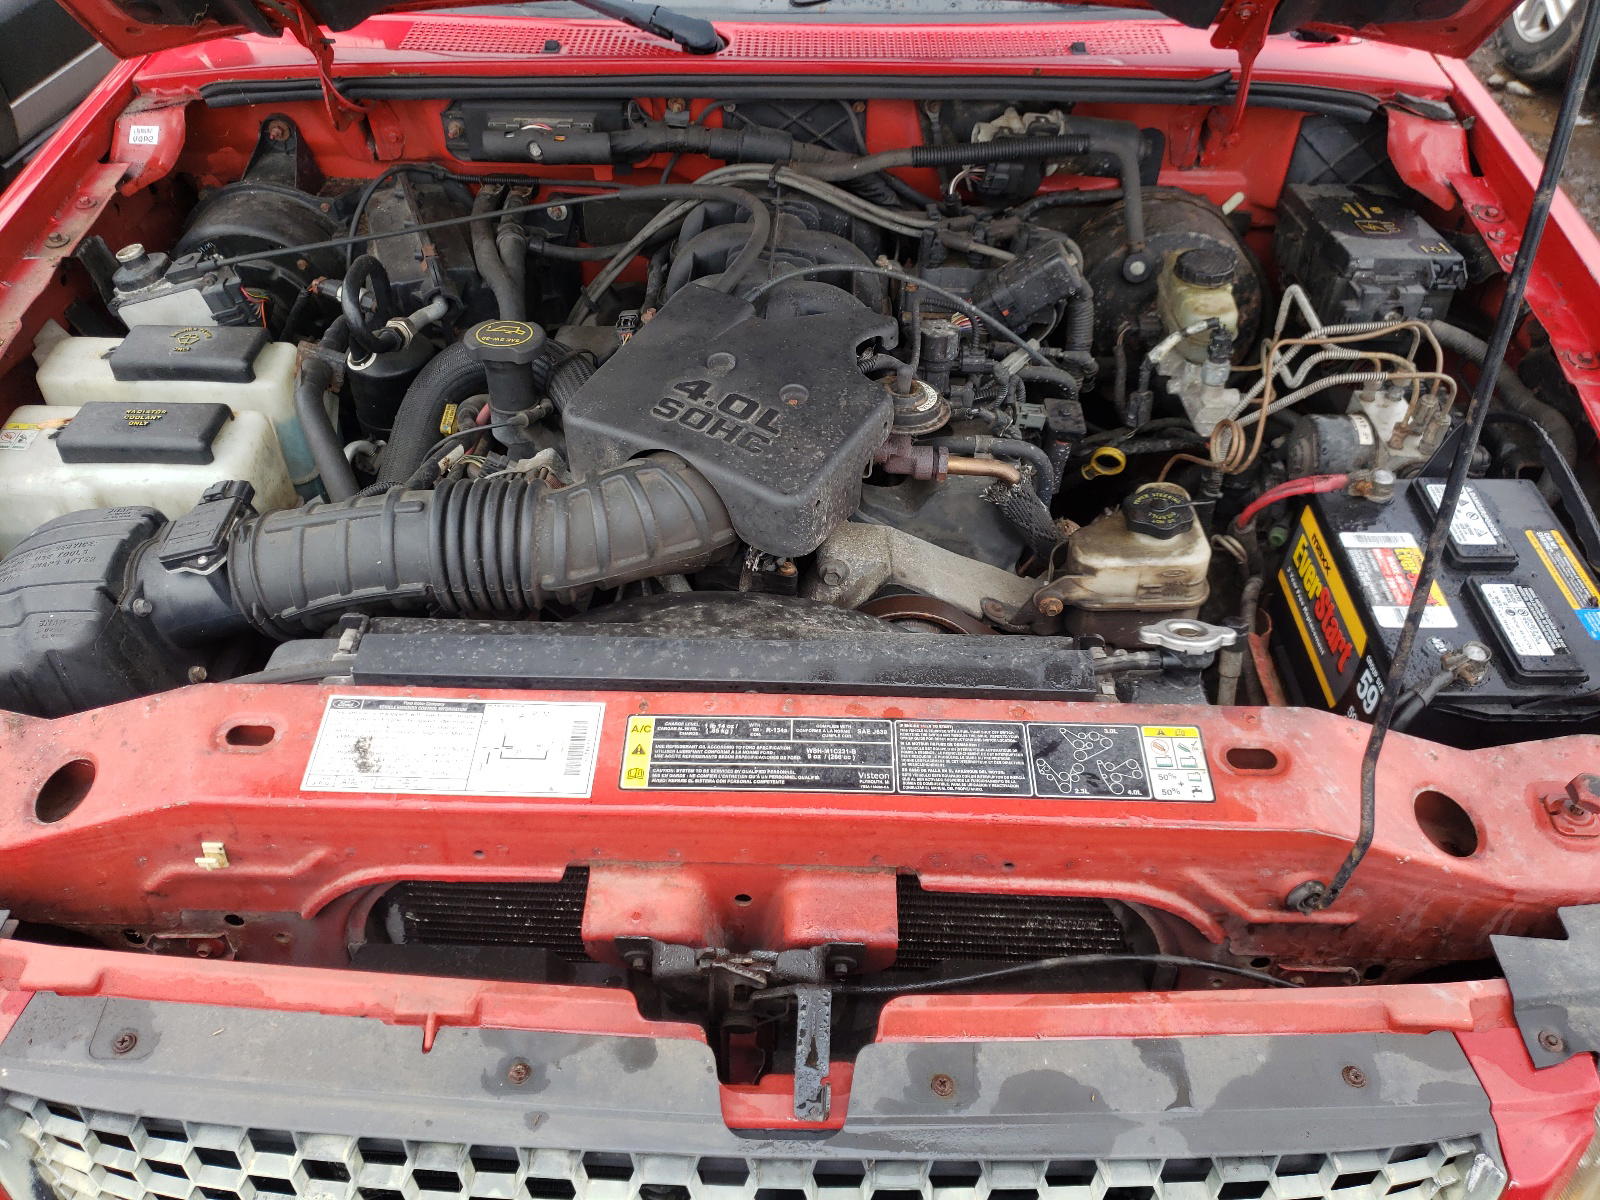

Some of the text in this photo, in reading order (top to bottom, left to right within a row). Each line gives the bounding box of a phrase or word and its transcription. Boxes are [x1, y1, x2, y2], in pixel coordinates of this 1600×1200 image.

[651, 397, 772, 454] SOHC
[672, 379, 781, 438] 4.0L
[1292, 533, 1353, 674] EverStart
[1302, 606, 1325, 656] Replacement
[1356, 668, 1379, 715] 59
[1366, 655, 1385, 696] GROUP SIZE
[631, 725, 651, 733] A/C
[857, 771, 890, 780] Visteon
[1158, 773, 1177, 781] 50%
[1161, 788, 1181, 796] 50%
